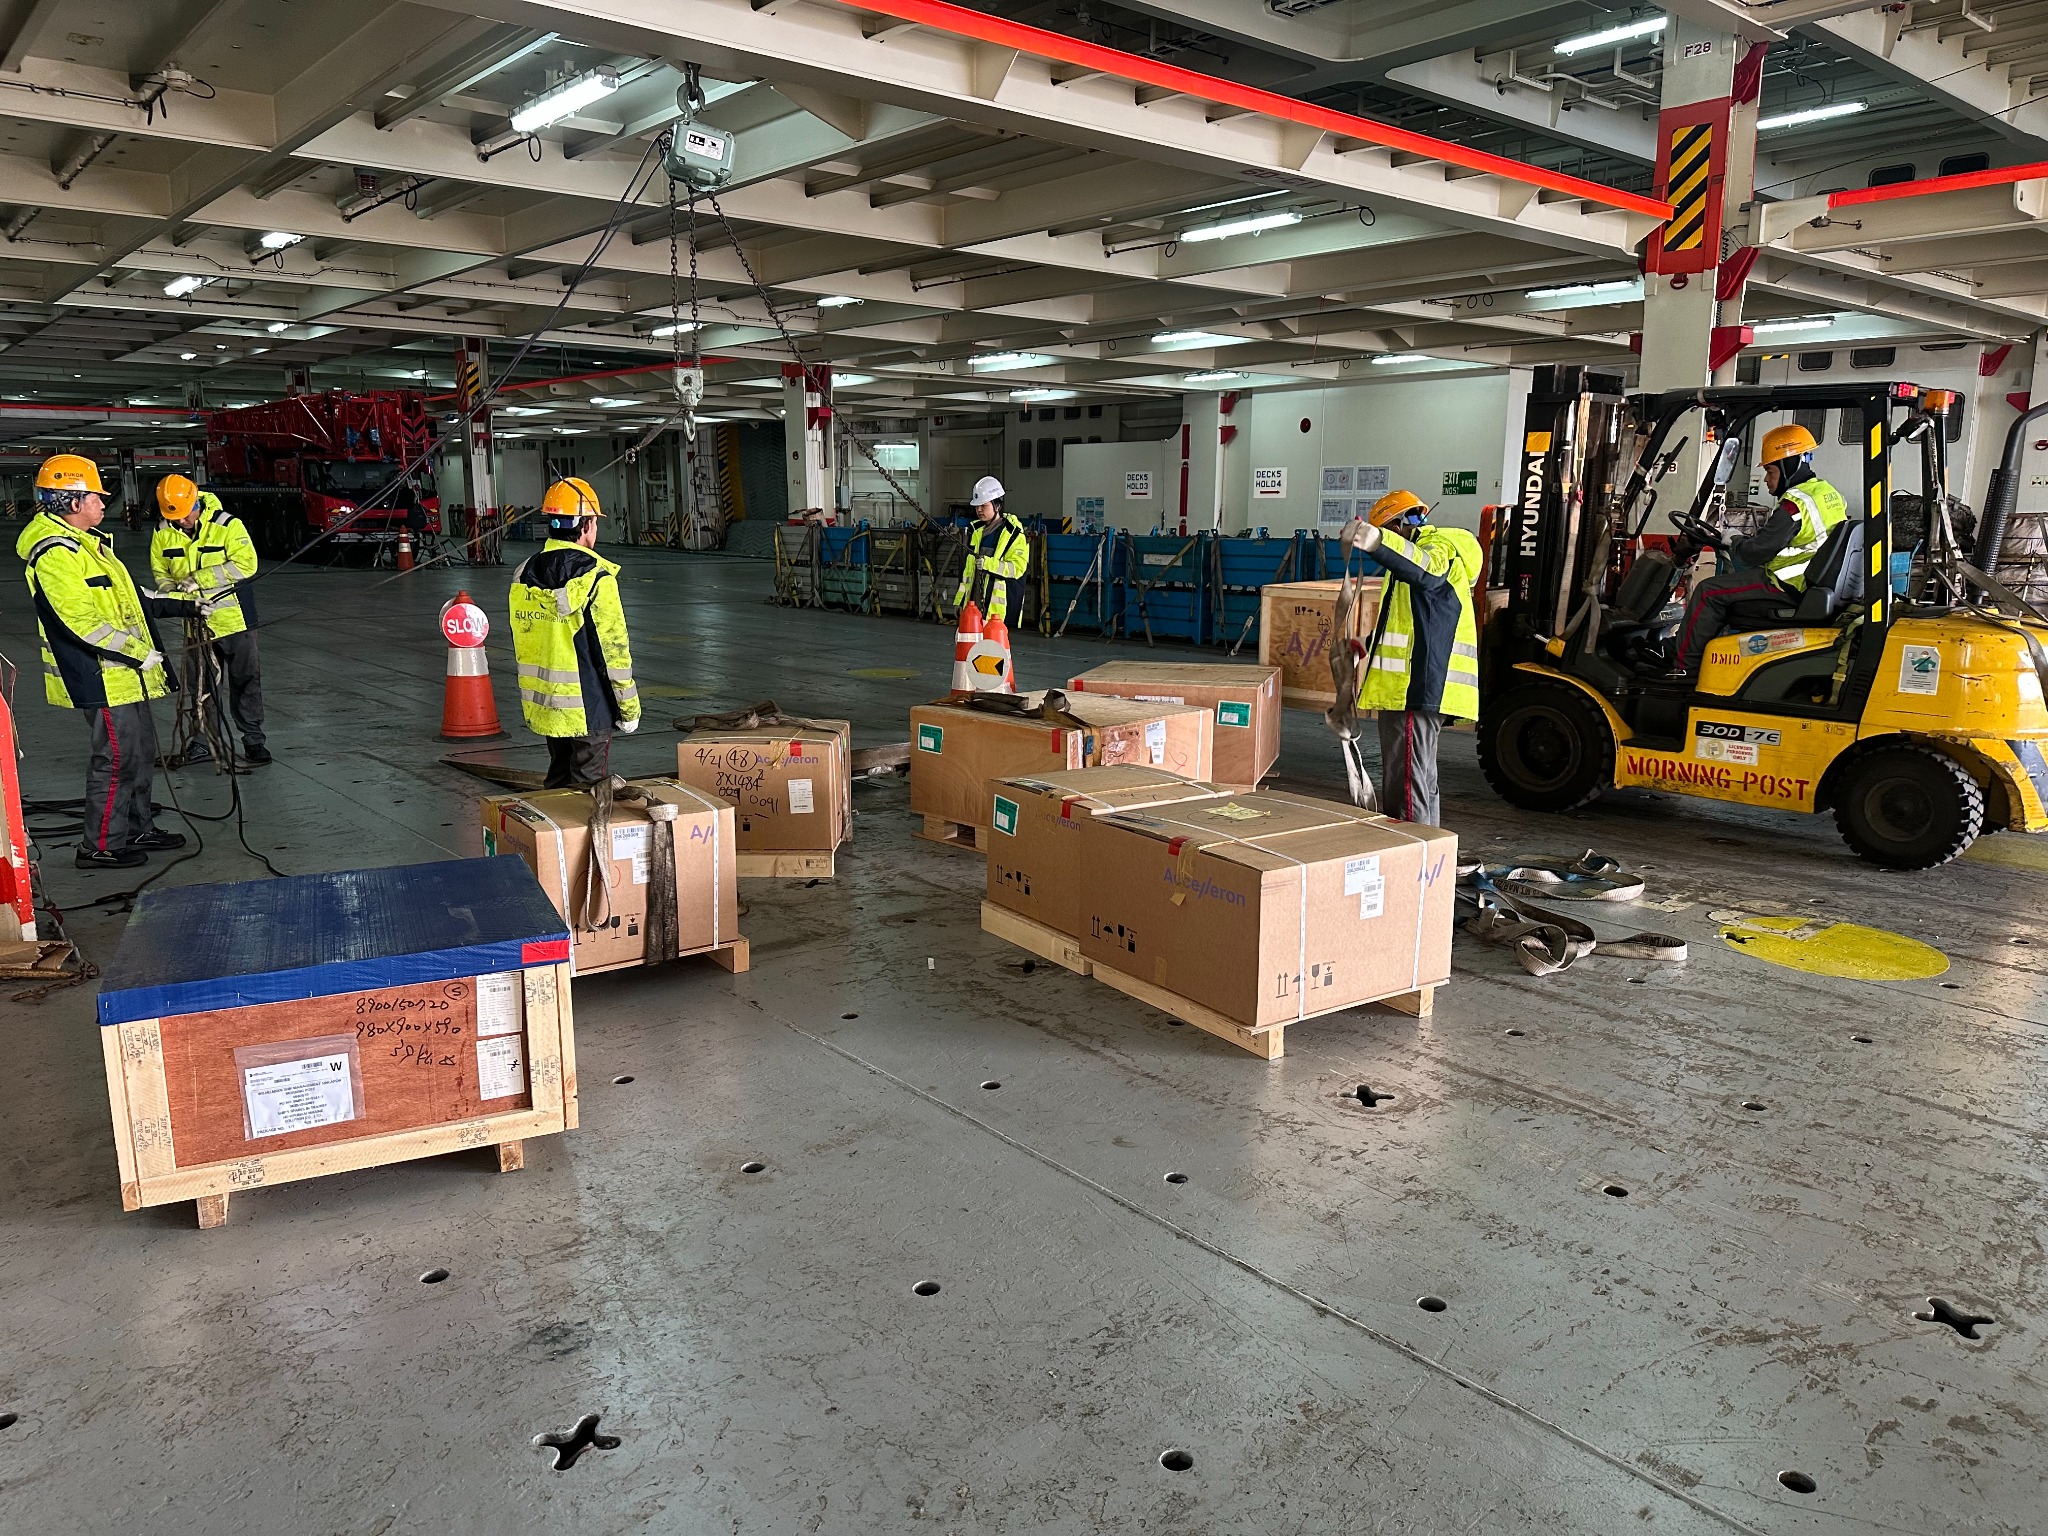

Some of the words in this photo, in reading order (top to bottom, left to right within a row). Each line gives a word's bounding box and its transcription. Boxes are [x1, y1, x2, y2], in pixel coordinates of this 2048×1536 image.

[1684, 41, 1712, 58] F28
[1443, 472, 1460, 485] EXIT
[1519, 450, 1546, 557] HYUNDAI
[446, 617, 485, 635] SLOW
[1726, 749, 1754, 757] PERSONNEL
[1626, 754, 1732, 789] MORNING
[1743, 771, 1810, 801] POST
[330, 1061, 342, 1072] W
